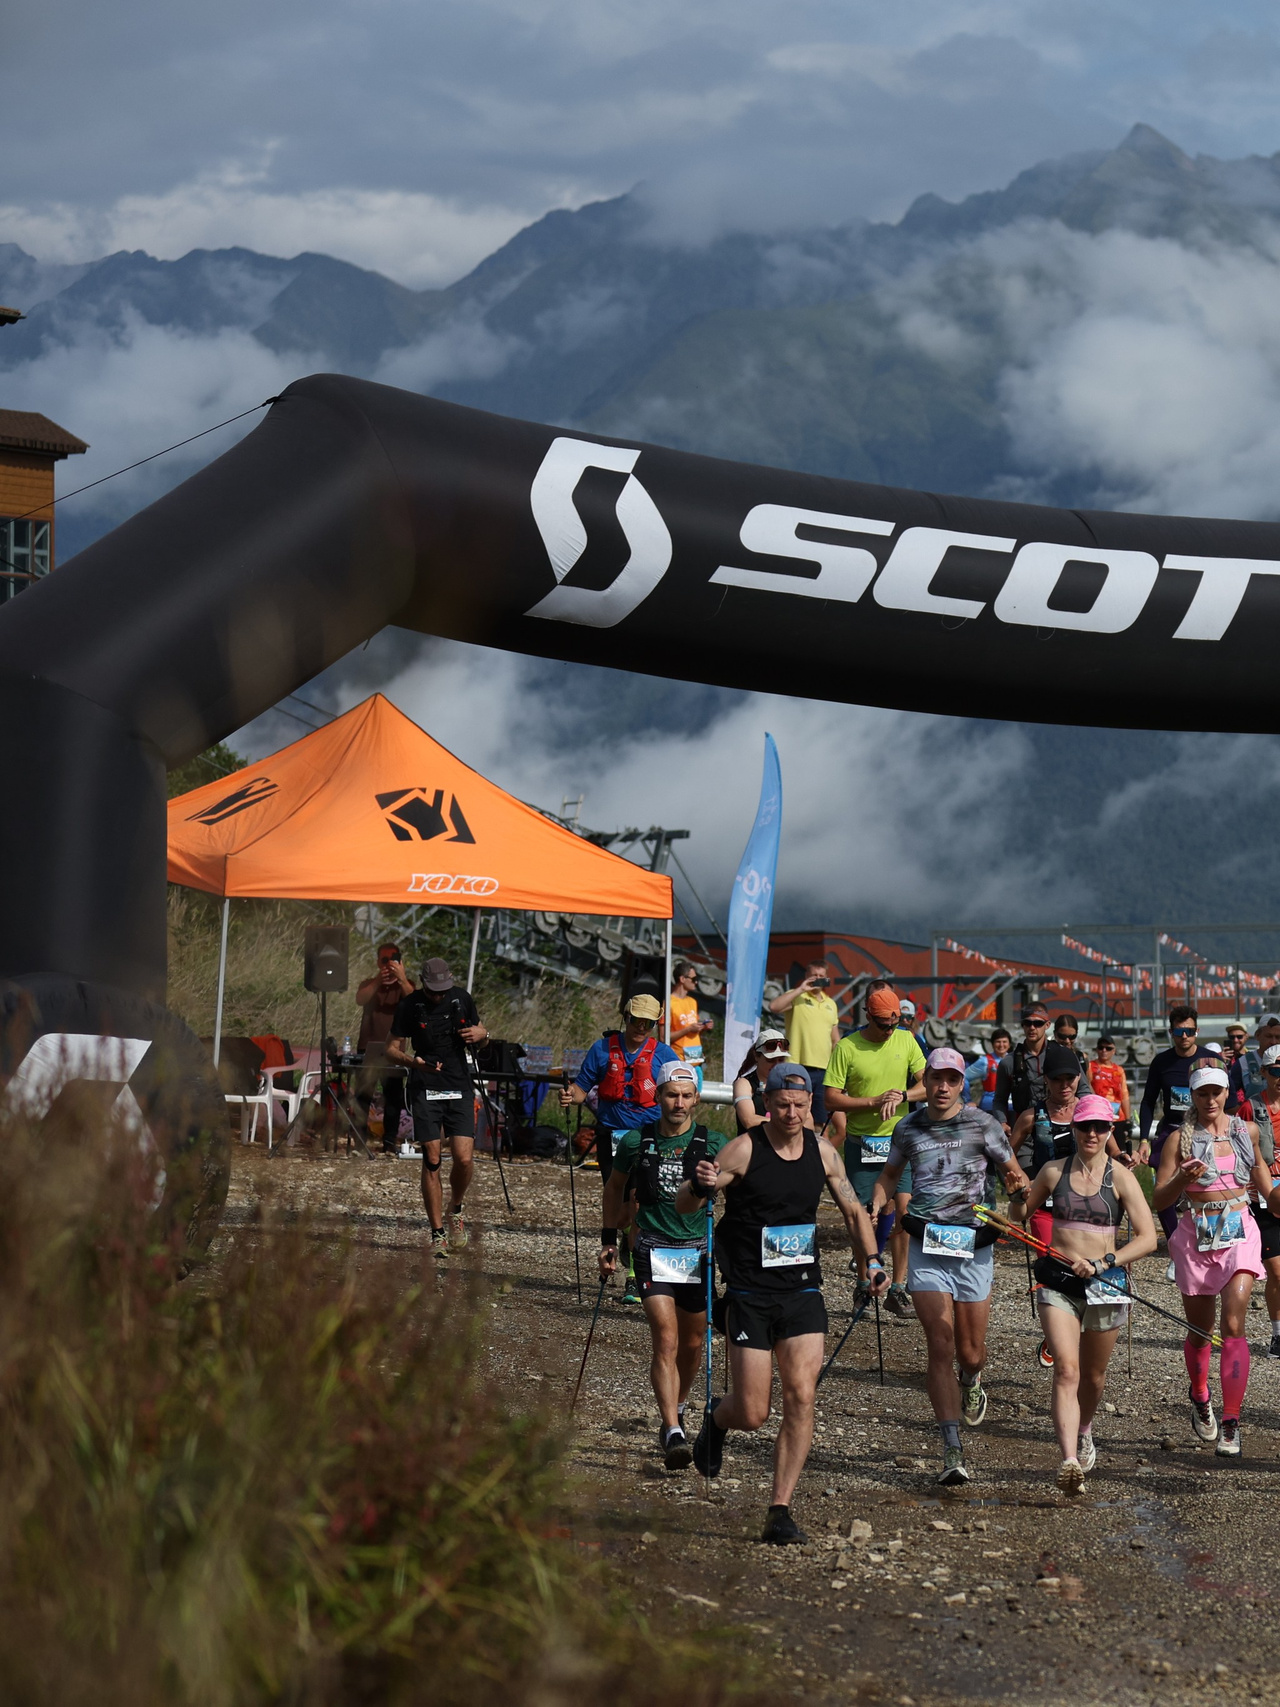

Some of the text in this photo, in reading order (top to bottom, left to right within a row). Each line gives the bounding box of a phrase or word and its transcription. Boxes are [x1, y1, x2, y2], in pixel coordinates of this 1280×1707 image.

[407, 873, 499, 896] YOKO
[870, 1141, 890, 1153] 126
[773, 1236, 800, 1252] 123
[936, 1229, 962, 1245] 129
